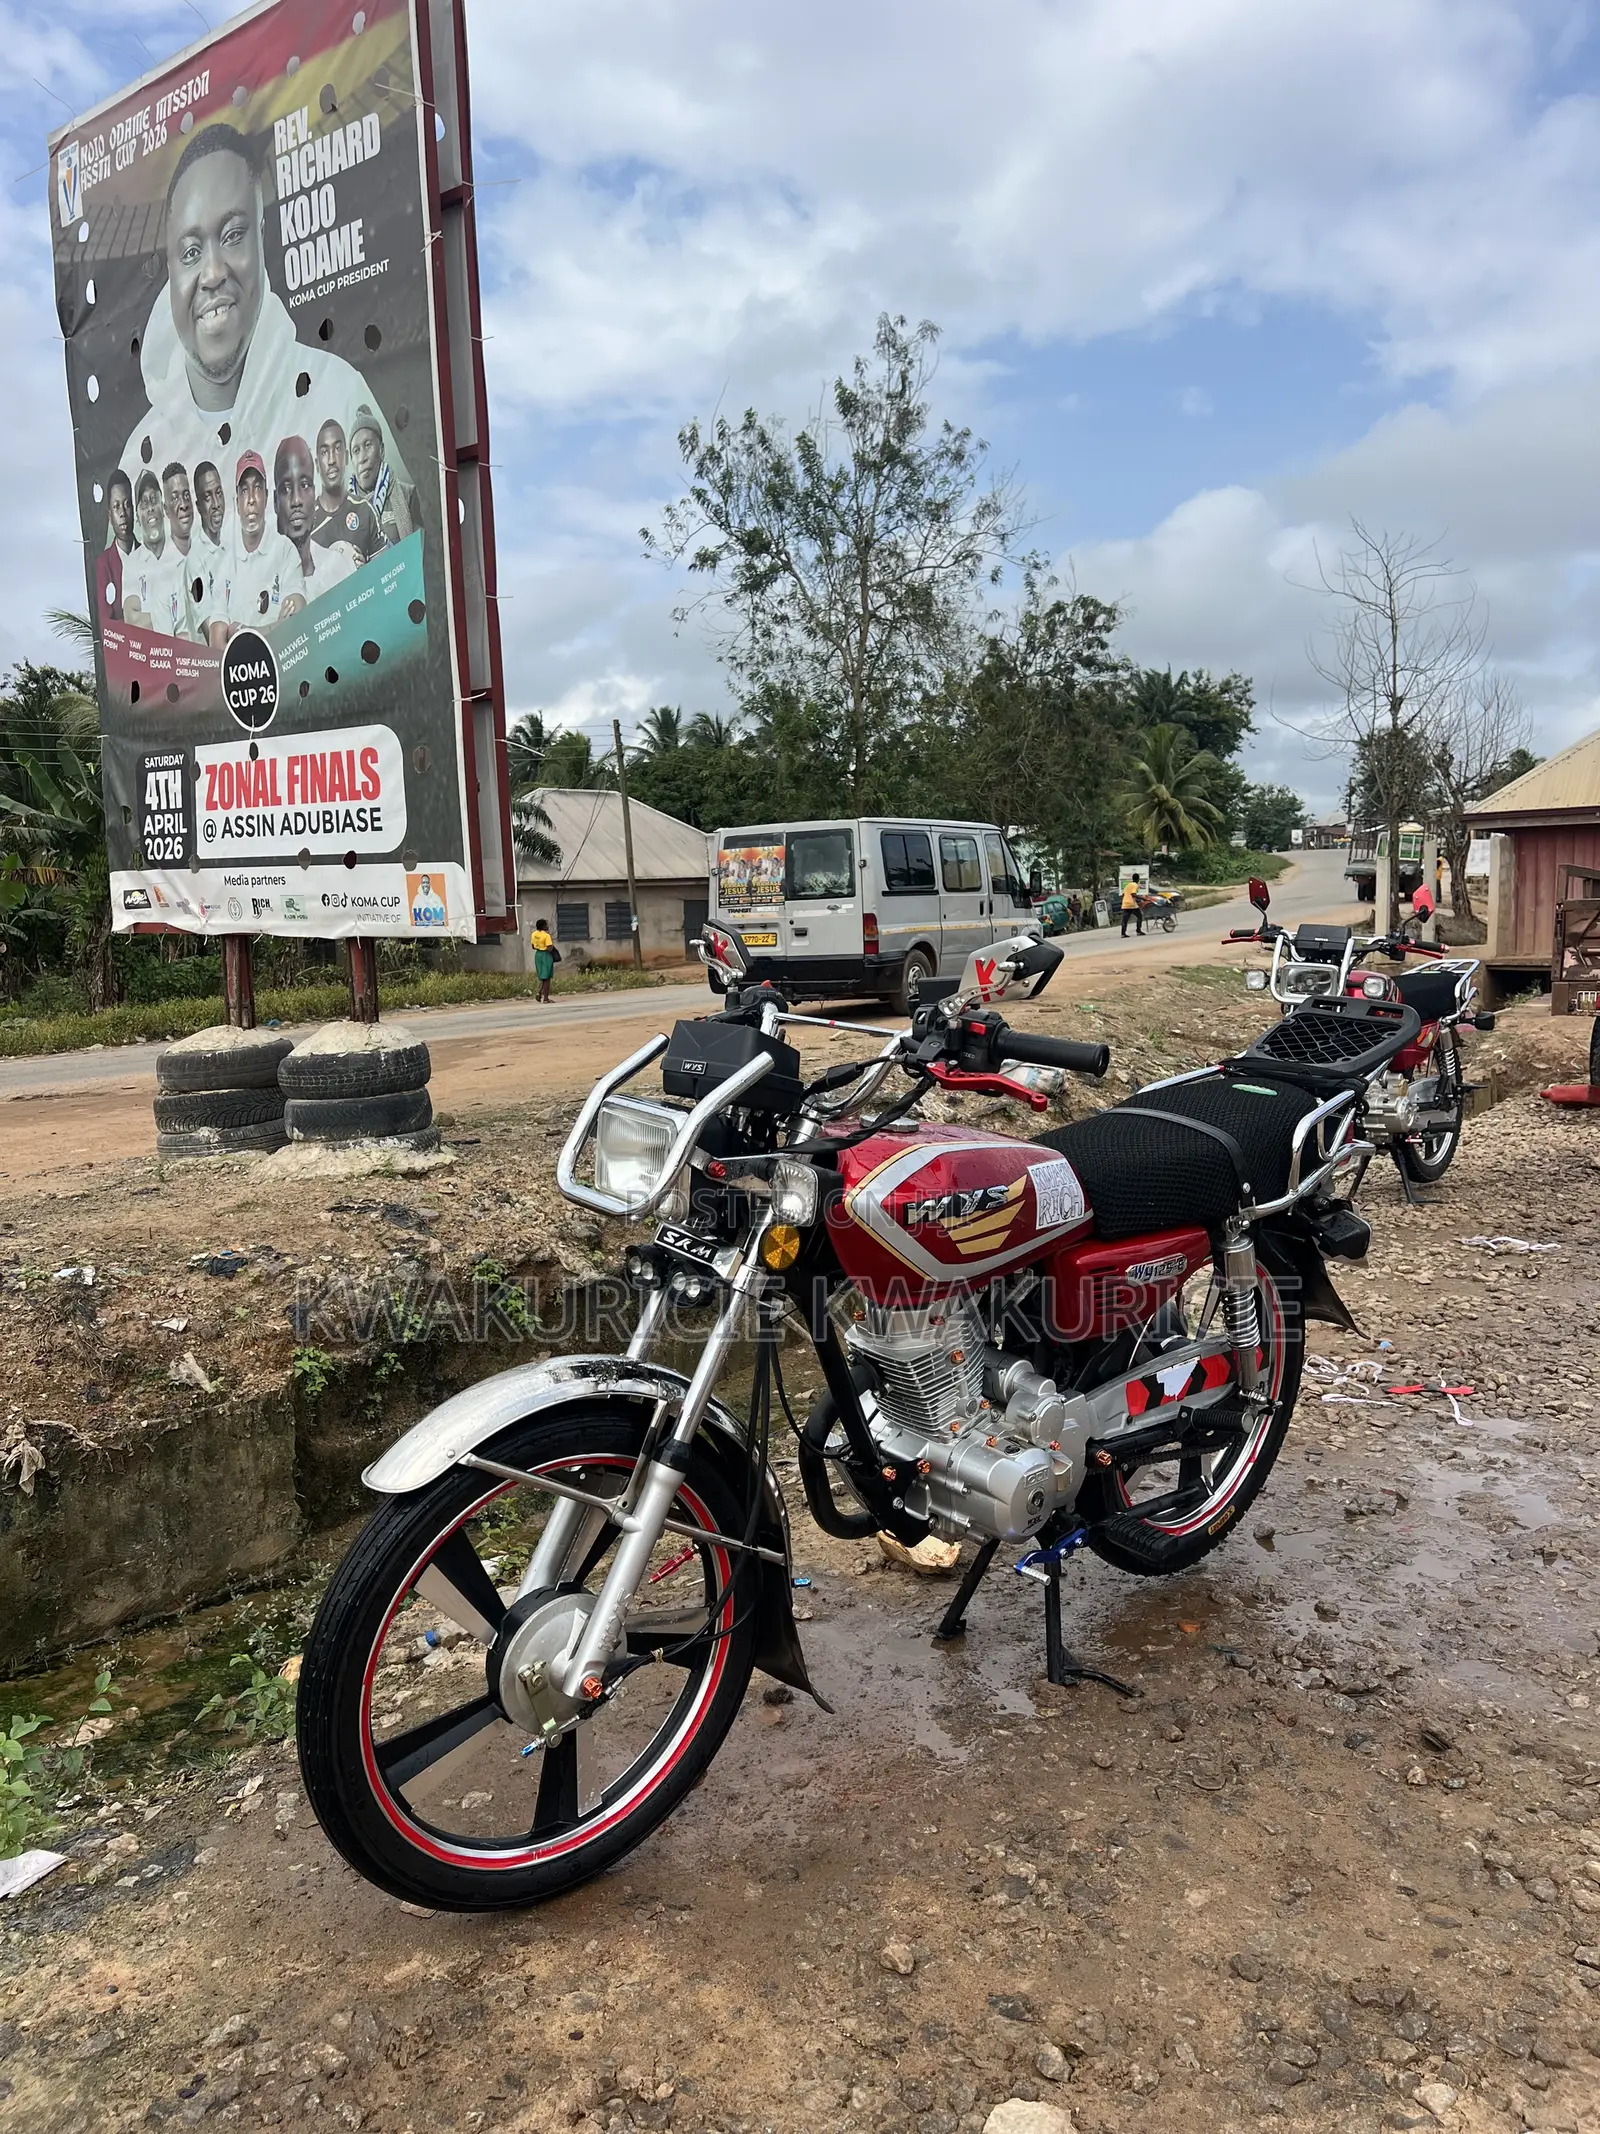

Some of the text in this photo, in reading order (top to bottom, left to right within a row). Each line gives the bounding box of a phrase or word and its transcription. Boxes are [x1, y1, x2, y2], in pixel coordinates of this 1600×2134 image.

[110, 106, 150, 151] ODAME
[156, 70, 210, 123] MISSION
[274, 106, 312, 155] REV.
[116, 140, 136, 171] CUP
[143, 121, 167, 156] 2026
[276, 113, 381, 200] RICHARD
[280, 183, 336, 246] KOJO
[284, 218, 365, 291] ODAME
[289, 259, 390, 309] KOMA CUP PRESIDENT
[345, 586, 375, 612] LEE ADDY
[313, 609, 342, 633] STEPHEN
[318, 623, 342, 643] APPIAH
[129, 640, 142, 649] YAW
[129, 651, 147, 662] PREKO
[150, 647, 173, 657] AWUDU
[278, 632, 309, 660] MAXWELL
[150, 659, 171, 670] ISAAKA
[191, 658, 220, 668] ALHASSAN
[281, 646, 309, 672] KONADU
[229, 660, 270, 683] KOMA
[229, 684, 276, 708] CUP 26
[144, 753, 185, 769] SATURDAY
[144, 769, 182, 811] 4TH
[205, 747, 381, 811] ZONAL FINALS
[143, 813, 187, 836] APRIL
[203, 807, 383, 843] @ ASSIN ADUBIASE
[144, 836, 183, 861] 2026
[224, 874, 286, 888] Media partners
[725, 887, 747, 895] JESUS
[757, 885, 780, 893] JESUS
[351, 896, 401, 907] KOMA CUP
[357, 914, 401, 923] INITIATIVE OF
[684, 1062, 703, 1071] WYS
[1038, 1183, 1083, 1226] RICH
